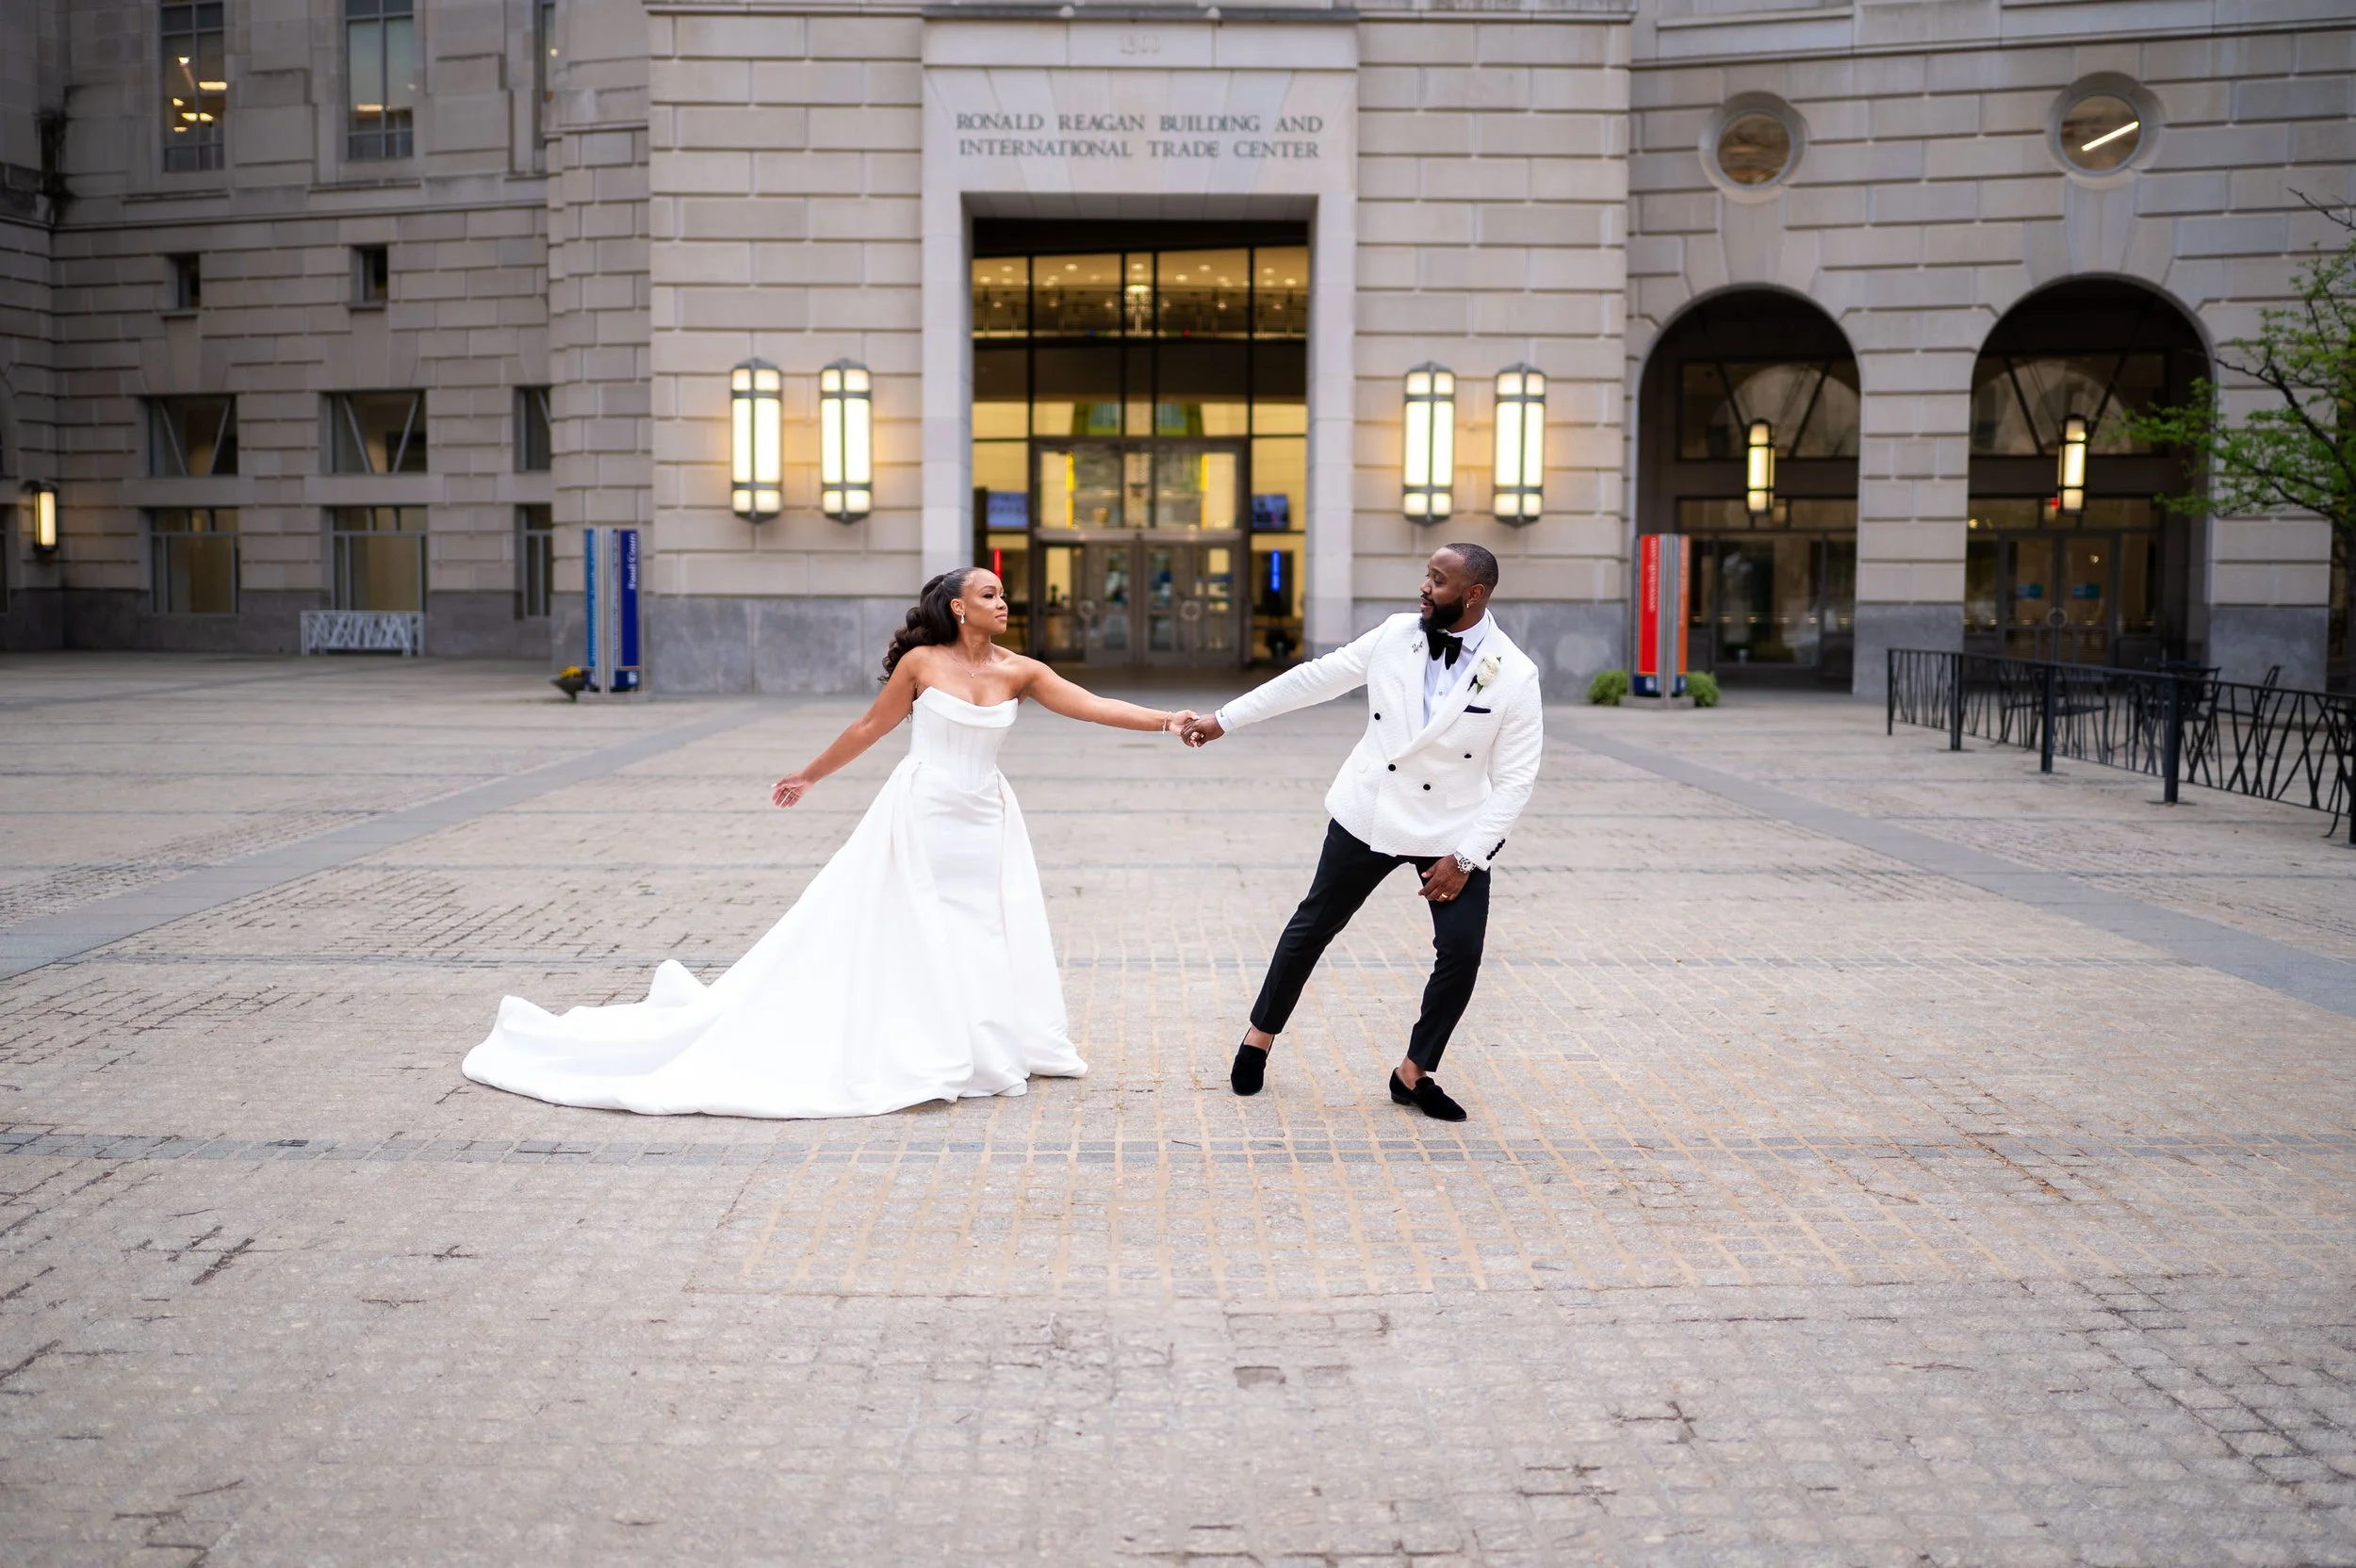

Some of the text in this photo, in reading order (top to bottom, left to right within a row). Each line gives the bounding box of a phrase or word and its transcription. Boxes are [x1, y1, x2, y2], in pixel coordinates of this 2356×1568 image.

[957, 113, 1323, 134] RONALD REAGAN BUILDING AND
[959, 139, 1319, 159] INTERNATIONAL TRADE CENTER
